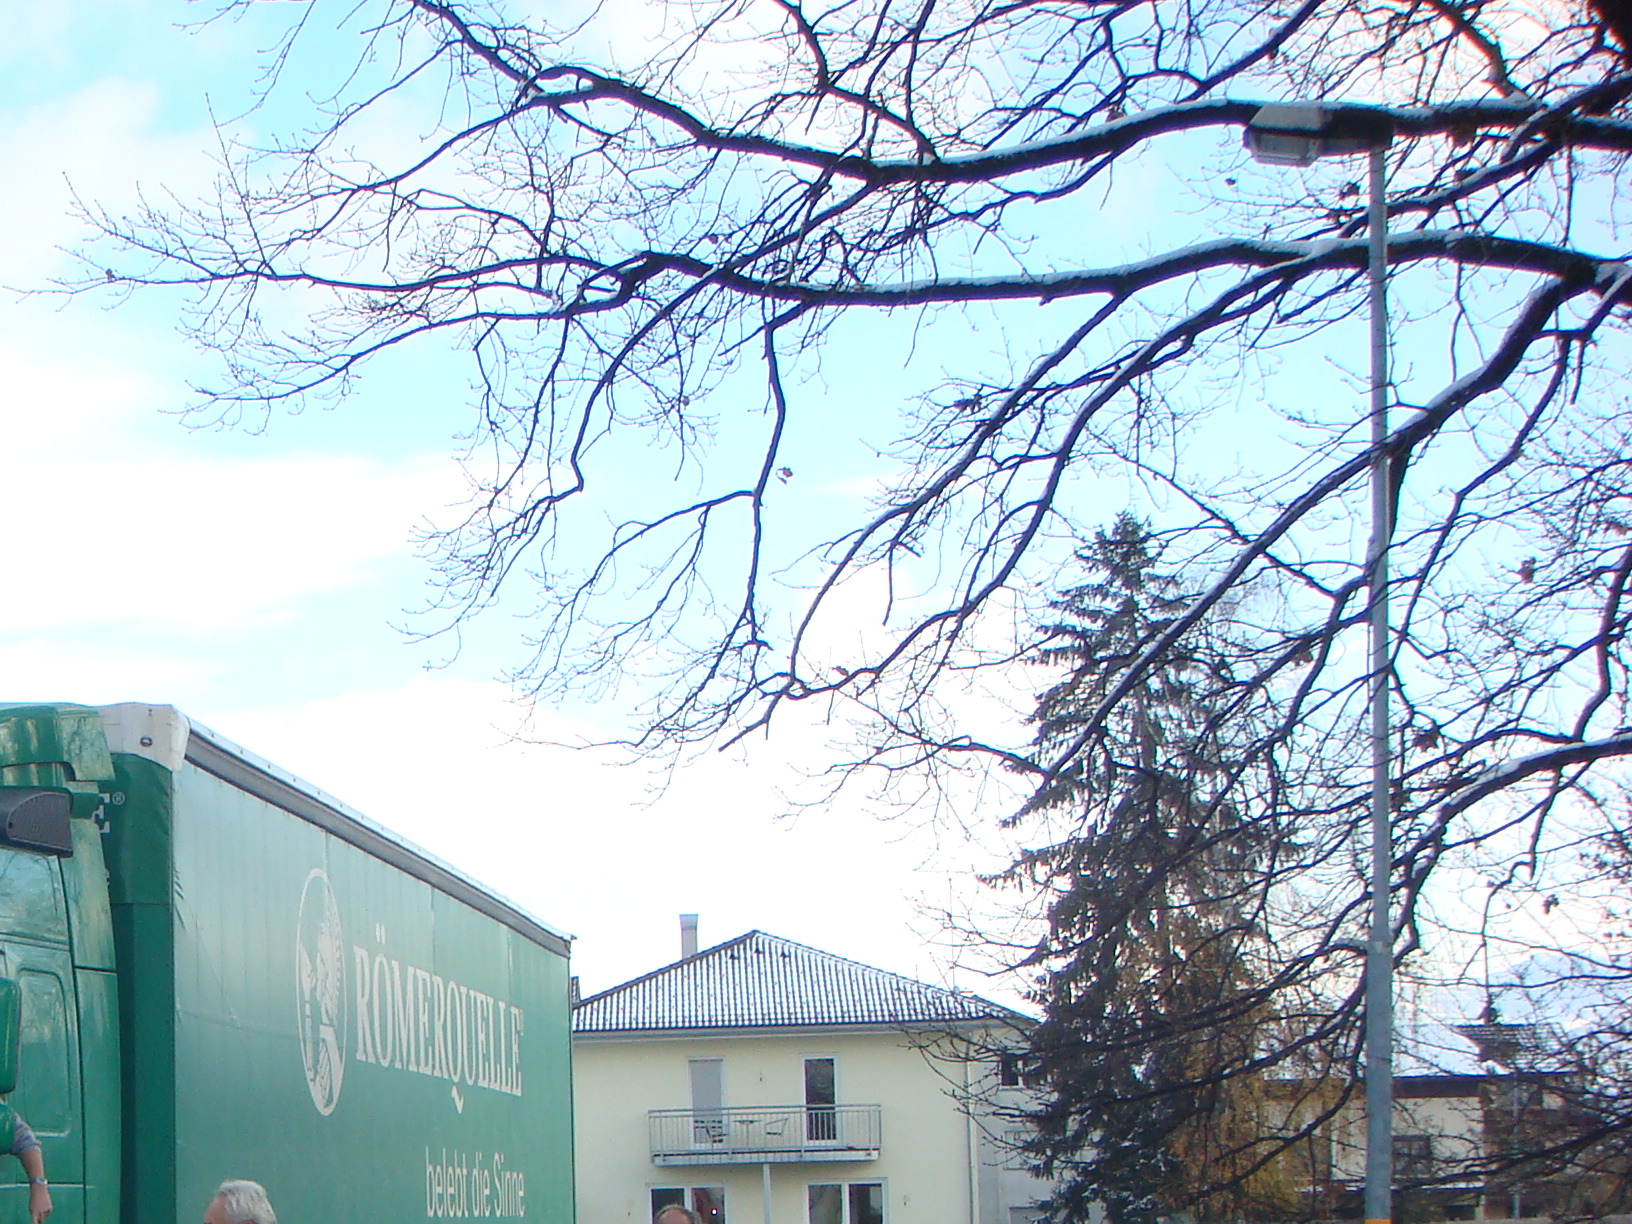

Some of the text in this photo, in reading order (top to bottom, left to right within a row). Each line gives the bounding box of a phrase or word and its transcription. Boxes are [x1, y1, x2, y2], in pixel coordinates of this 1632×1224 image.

[353, 922, 523, 1114] RÖMERQUELLE
[425, 1145, 525, 1218] belebt die Sinne
